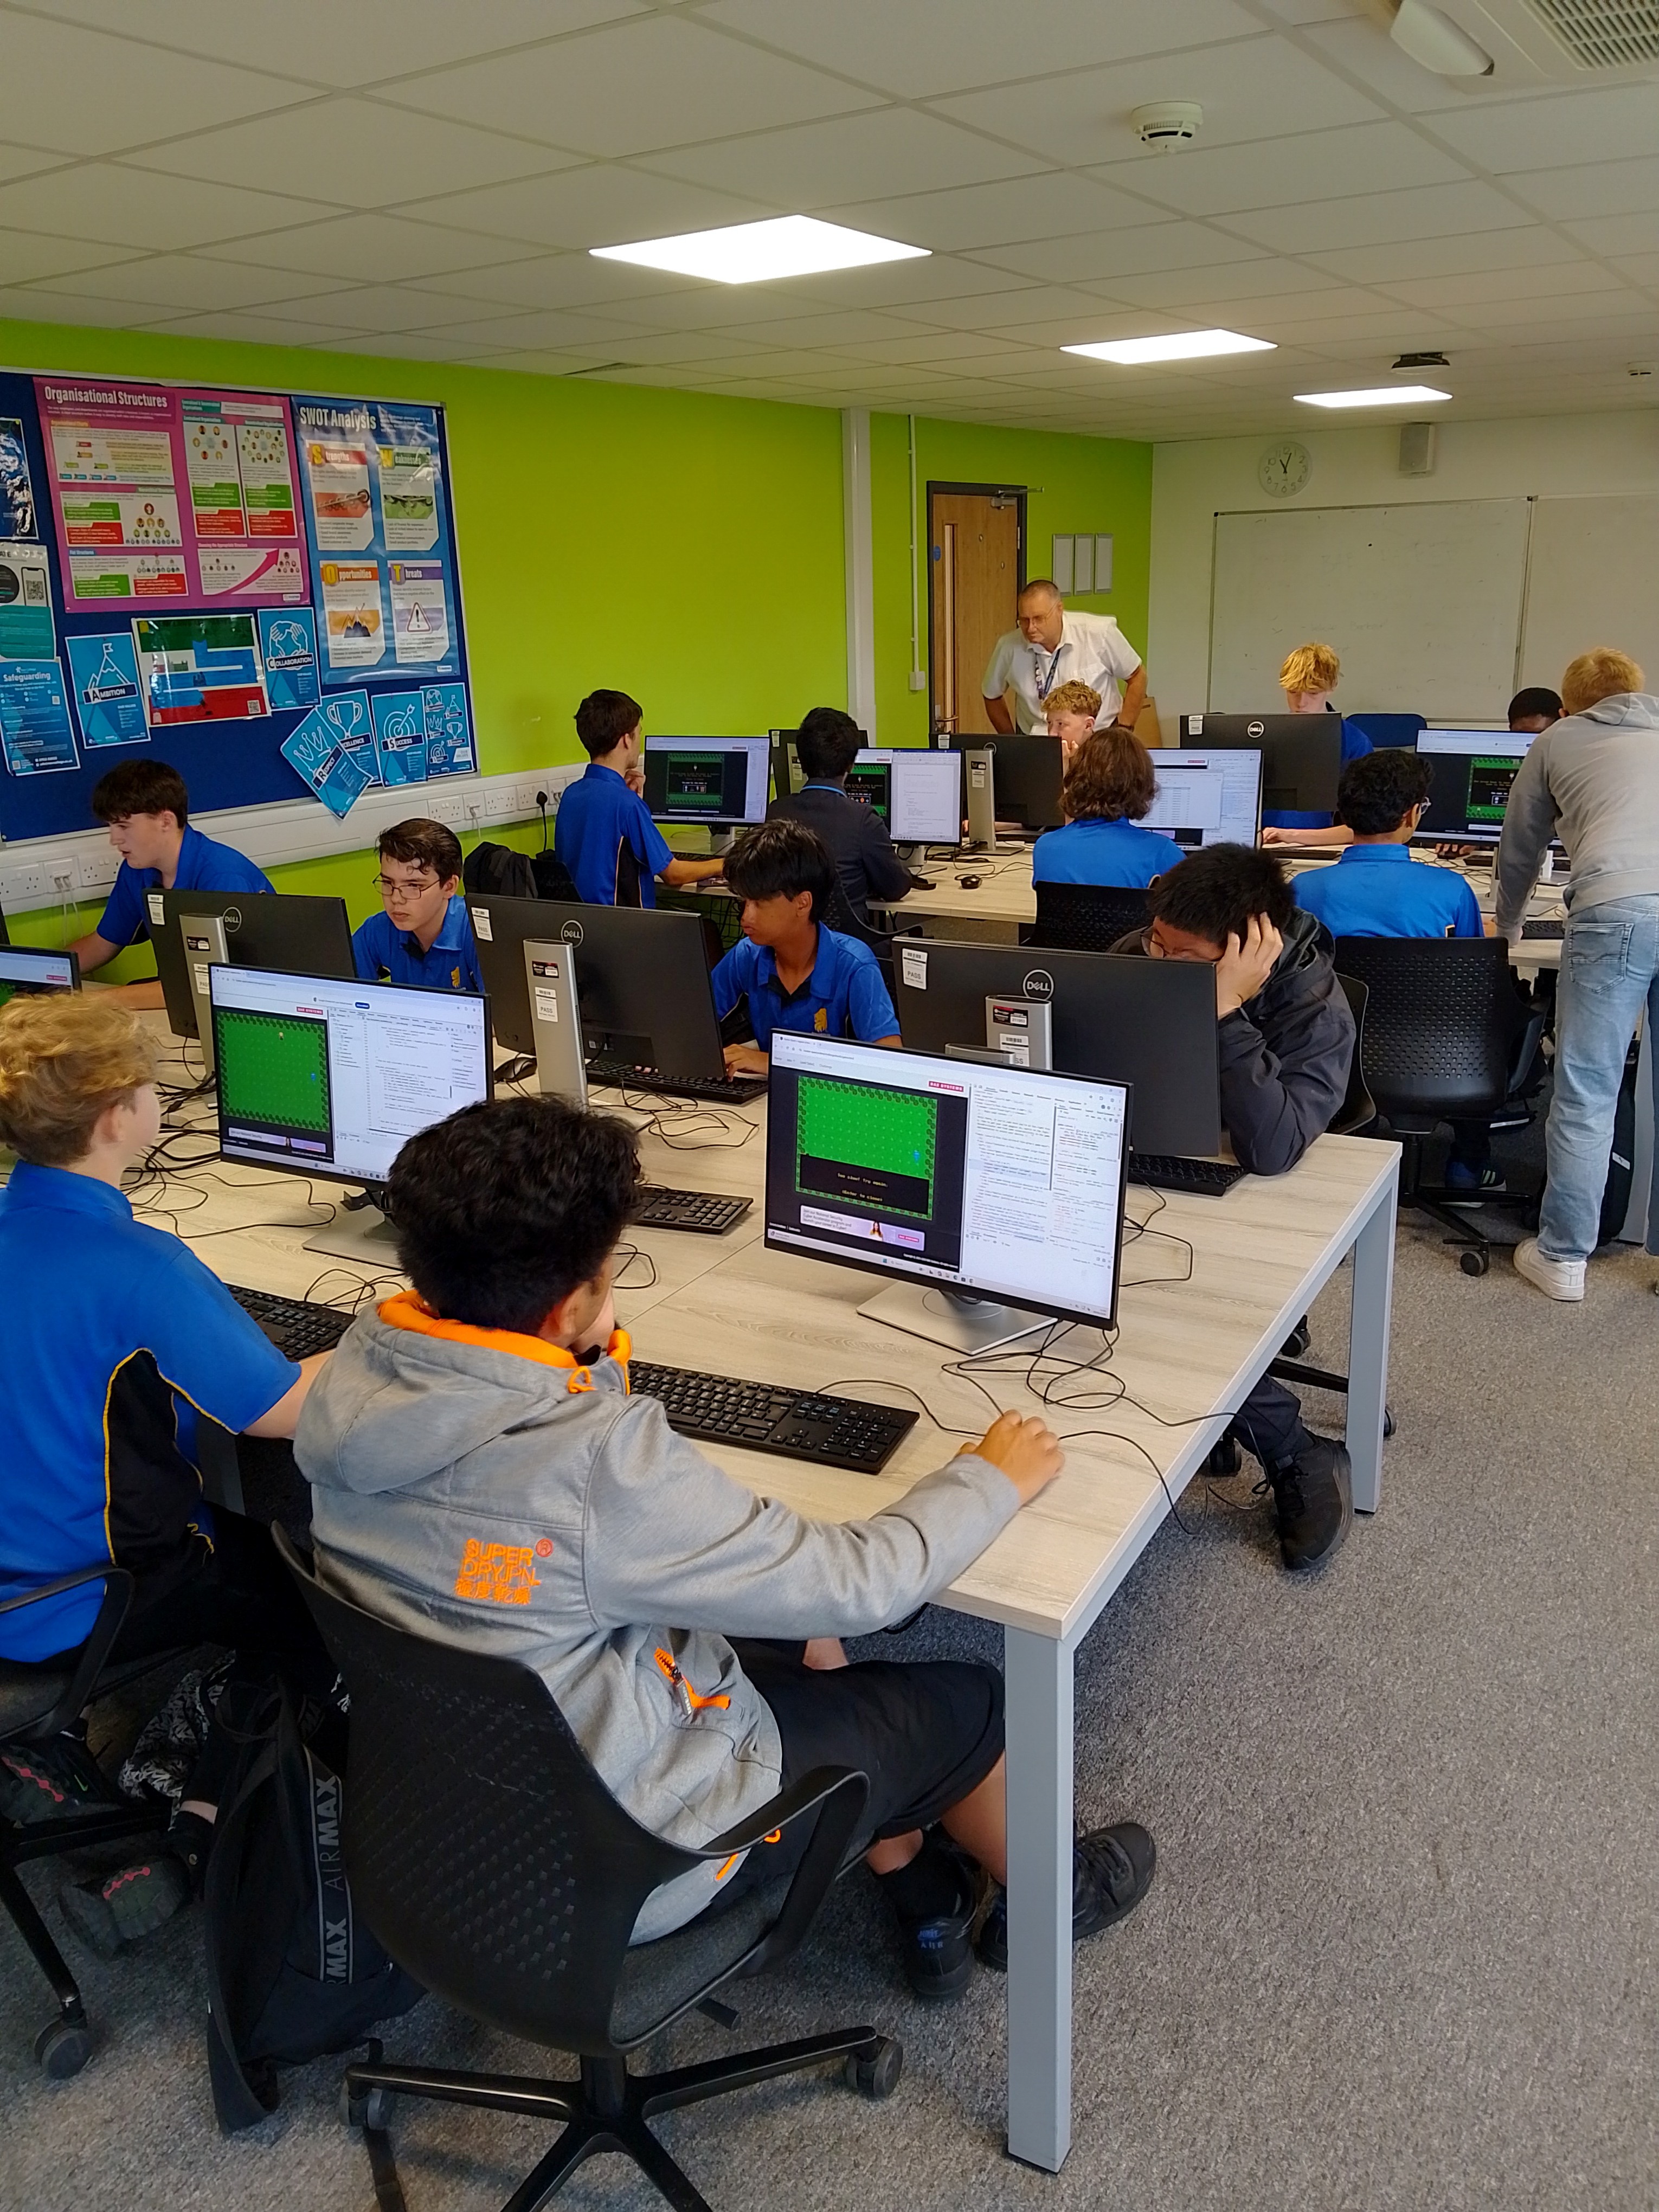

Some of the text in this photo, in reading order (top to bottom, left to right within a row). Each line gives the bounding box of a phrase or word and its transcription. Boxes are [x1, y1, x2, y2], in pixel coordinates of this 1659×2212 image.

[44, 386, 117, 404] Organisational
[118, 391, 168, 407] Structures
[299, 407, 329, 426] SWOT
[331, 409, 376, 432] Analysis
[1299, 455, 1305, 464] 2
[1267, 476, 1272, 484] 8
[393, 565, 422, 582] Threats
[268, 657, 312, 668] COLLABORATION
[3, 672, 51, 683] Safeguarding
[92, 688, 126, 702] AMBITION
[343, 737, 365, 748] CELLENCE
[389, 738, 413, 749] SUCCESS
[318, 757, 335, 781] RESPECT
[564, 930, 581, 939] DELL
[907, 970, 921, 979] PASS
[1026, 981, 1051, 992] DELL
[540, 1006, 554, 1014] PASS
[466, 1538, 533, 1567] SUPER
[316, 1775, 339, 1846] MAX
[325, 1918, 347, 1977] MAX
